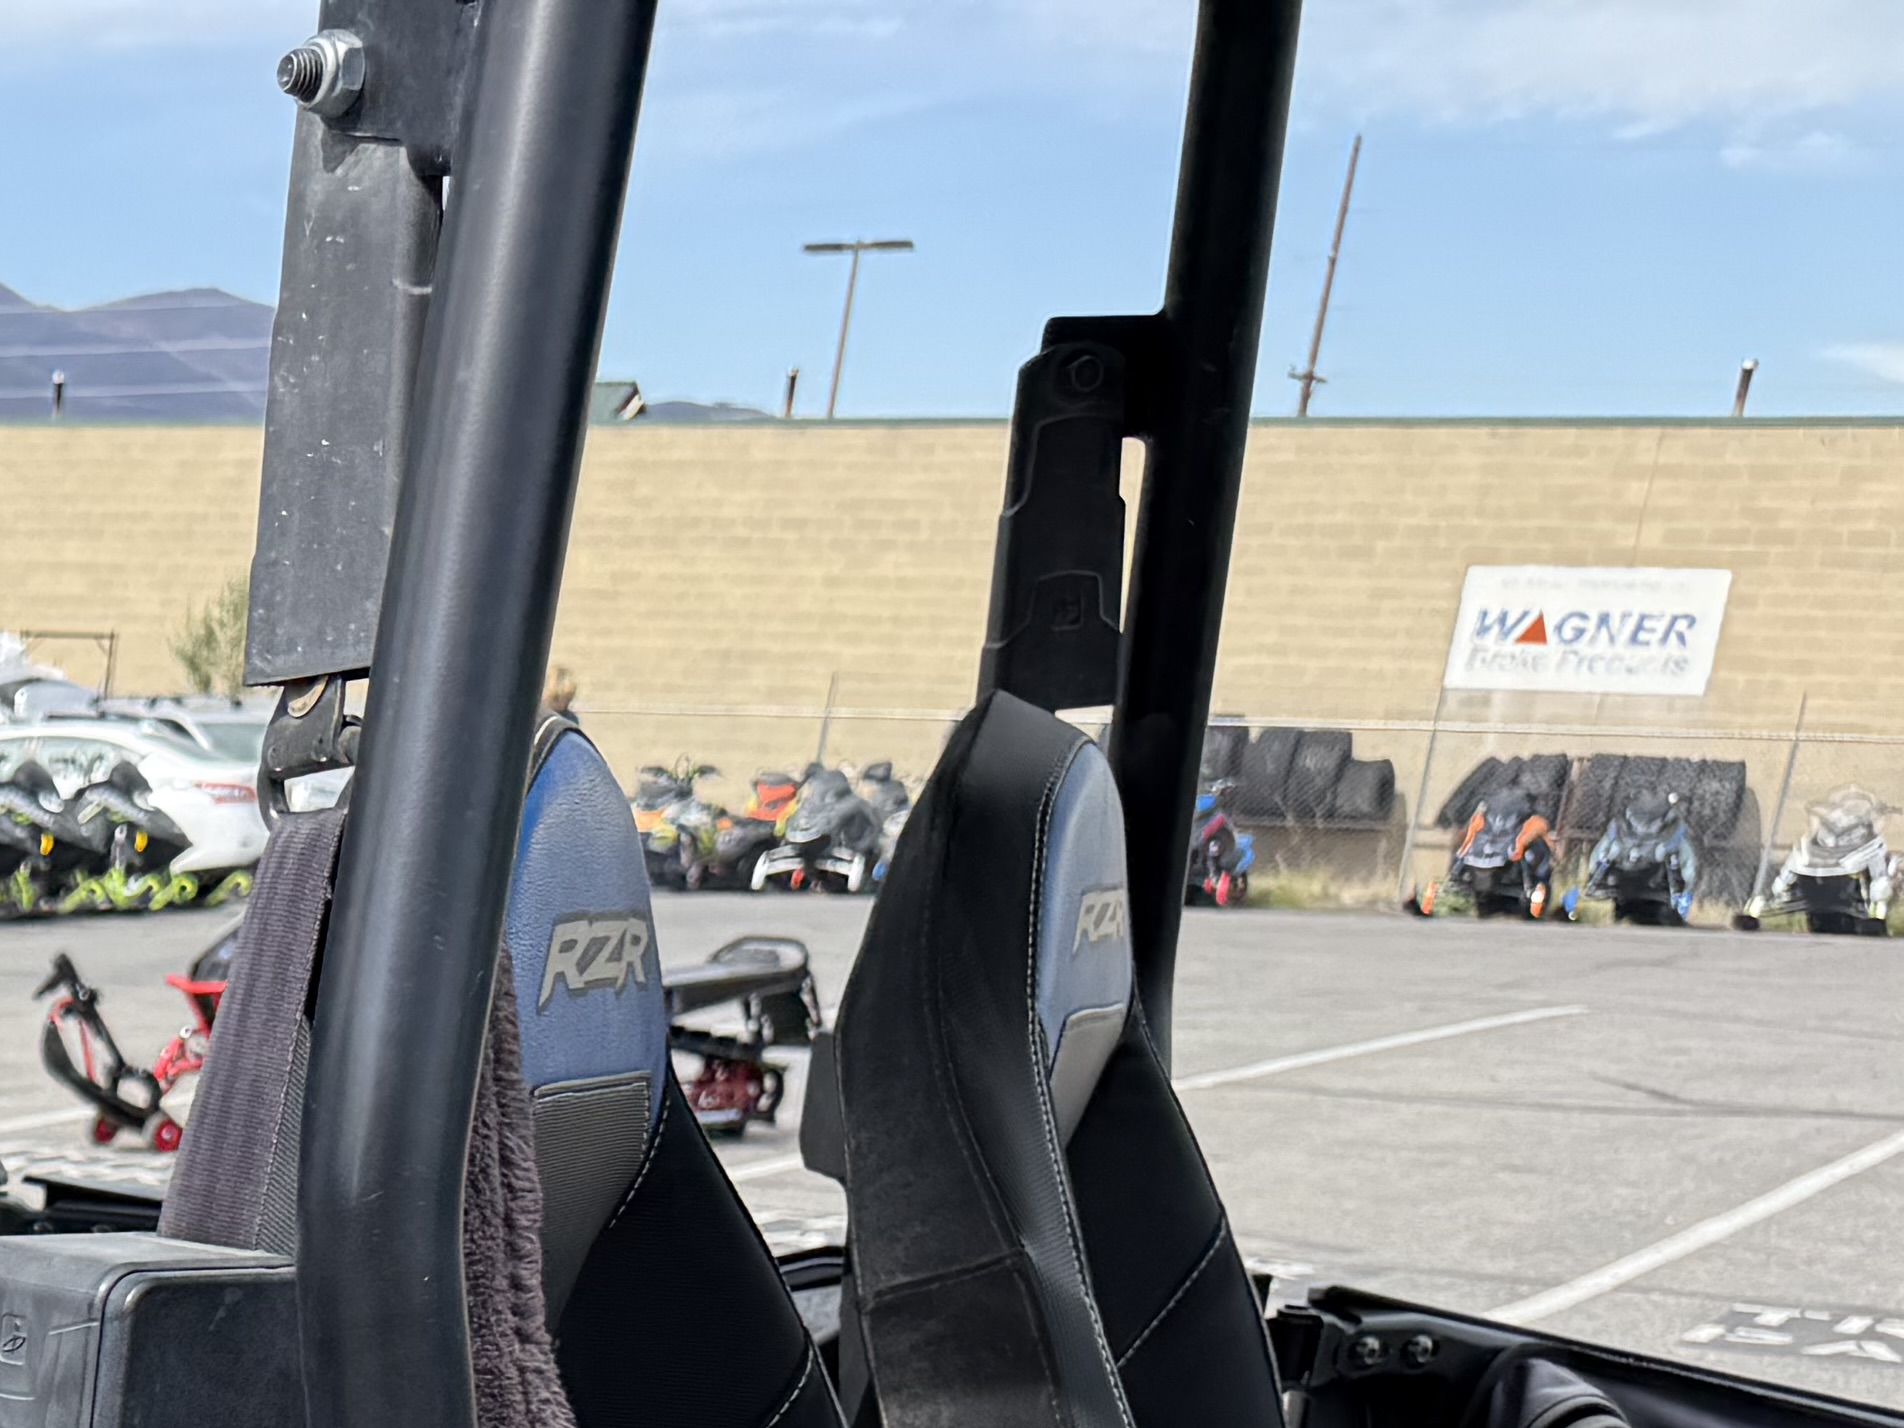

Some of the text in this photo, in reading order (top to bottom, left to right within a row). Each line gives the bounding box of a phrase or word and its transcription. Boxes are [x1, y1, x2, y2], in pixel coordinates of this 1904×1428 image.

[1476, 608, 1697, 648] WAGNER
[1072, 888, 1124, 954] RZR
[536, 910, 652, 1016] RZR
